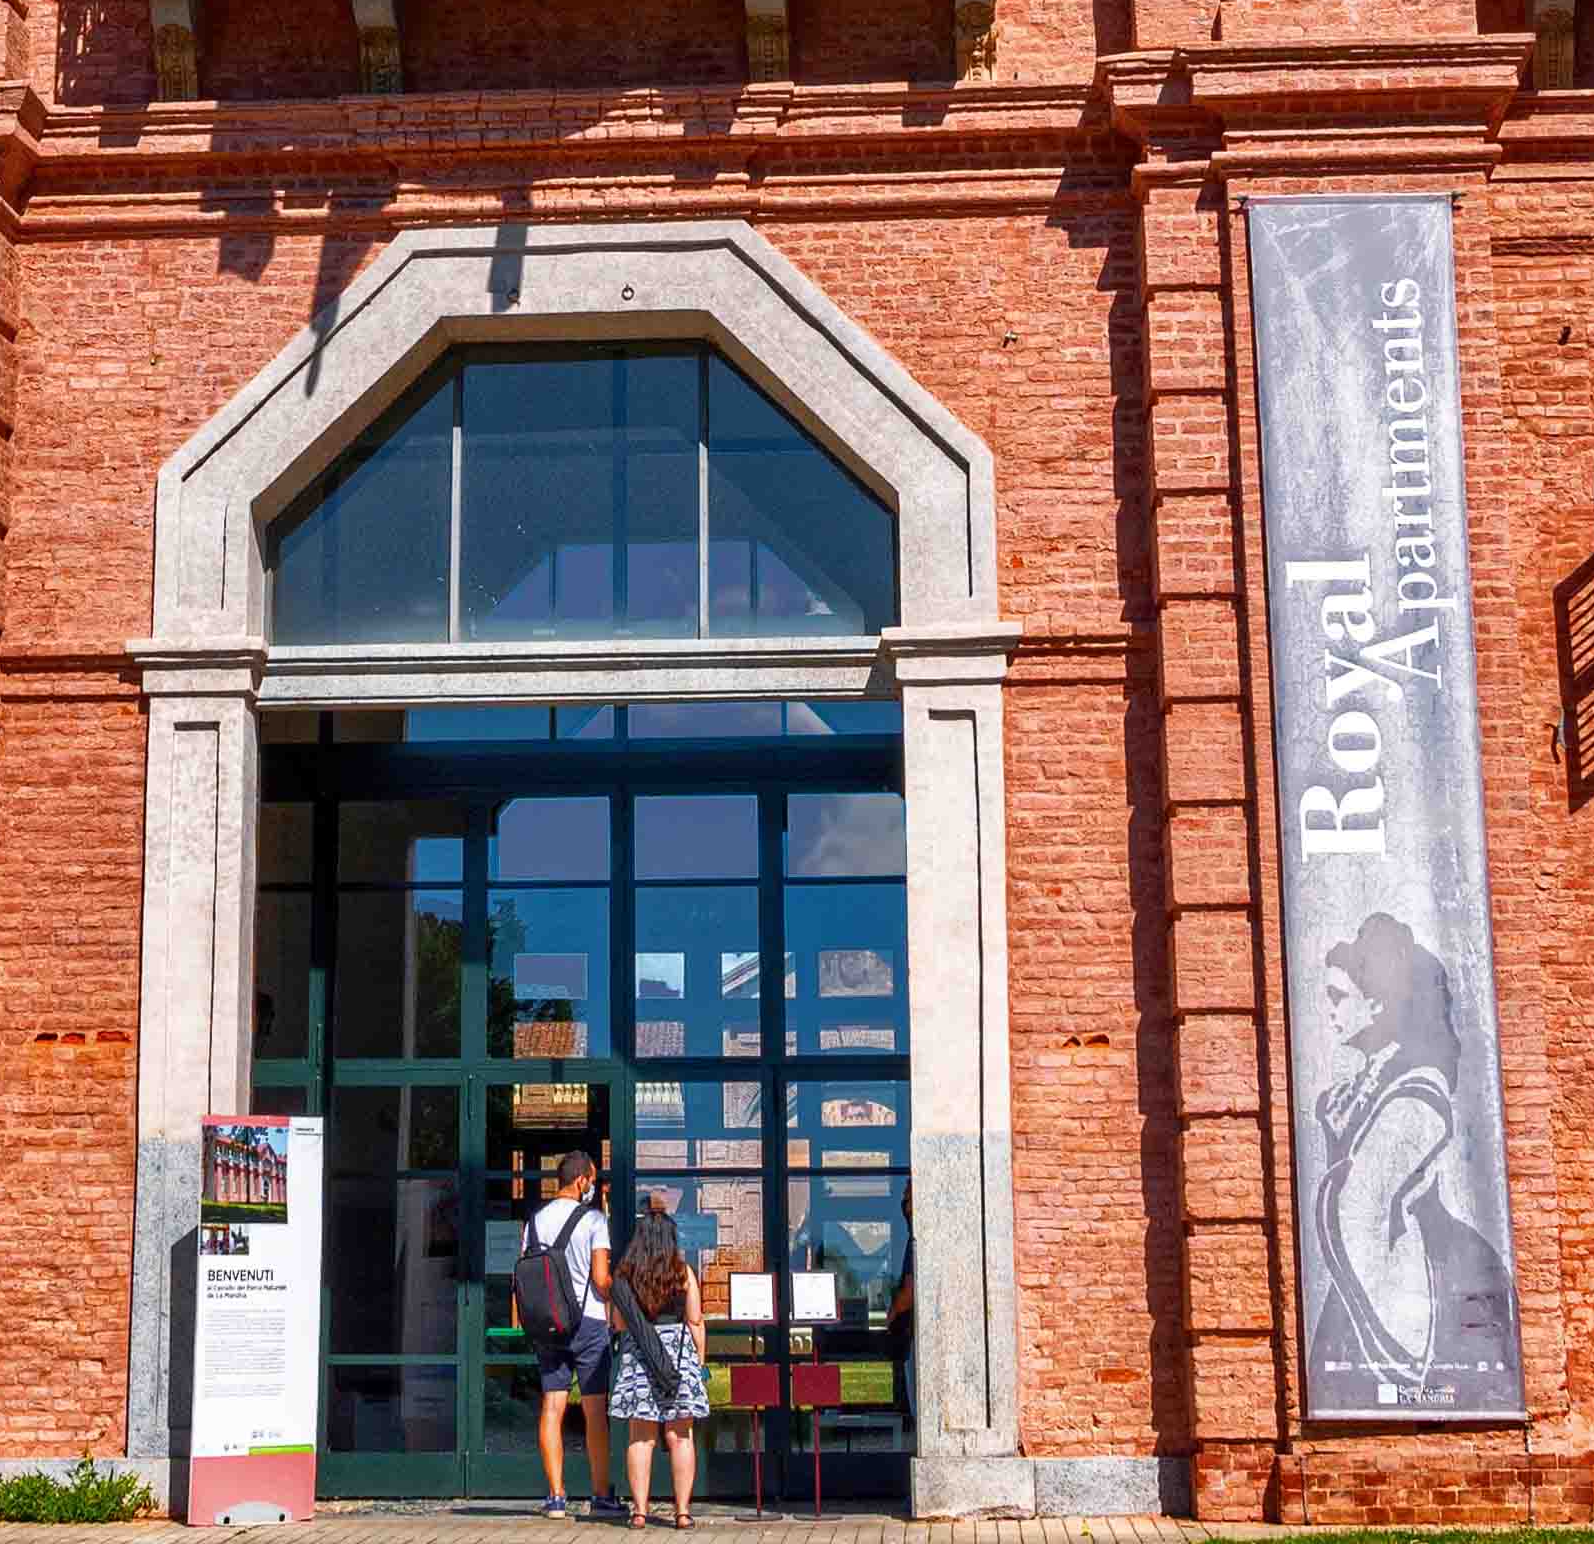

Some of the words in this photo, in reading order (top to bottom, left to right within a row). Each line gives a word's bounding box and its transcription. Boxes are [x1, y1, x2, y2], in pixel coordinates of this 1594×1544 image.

[1360, 276, 1458, 689] Apartments
[1286, 553, 1404, 864] Royal
[207, 1269, 274, 1282] BENVENUTI
